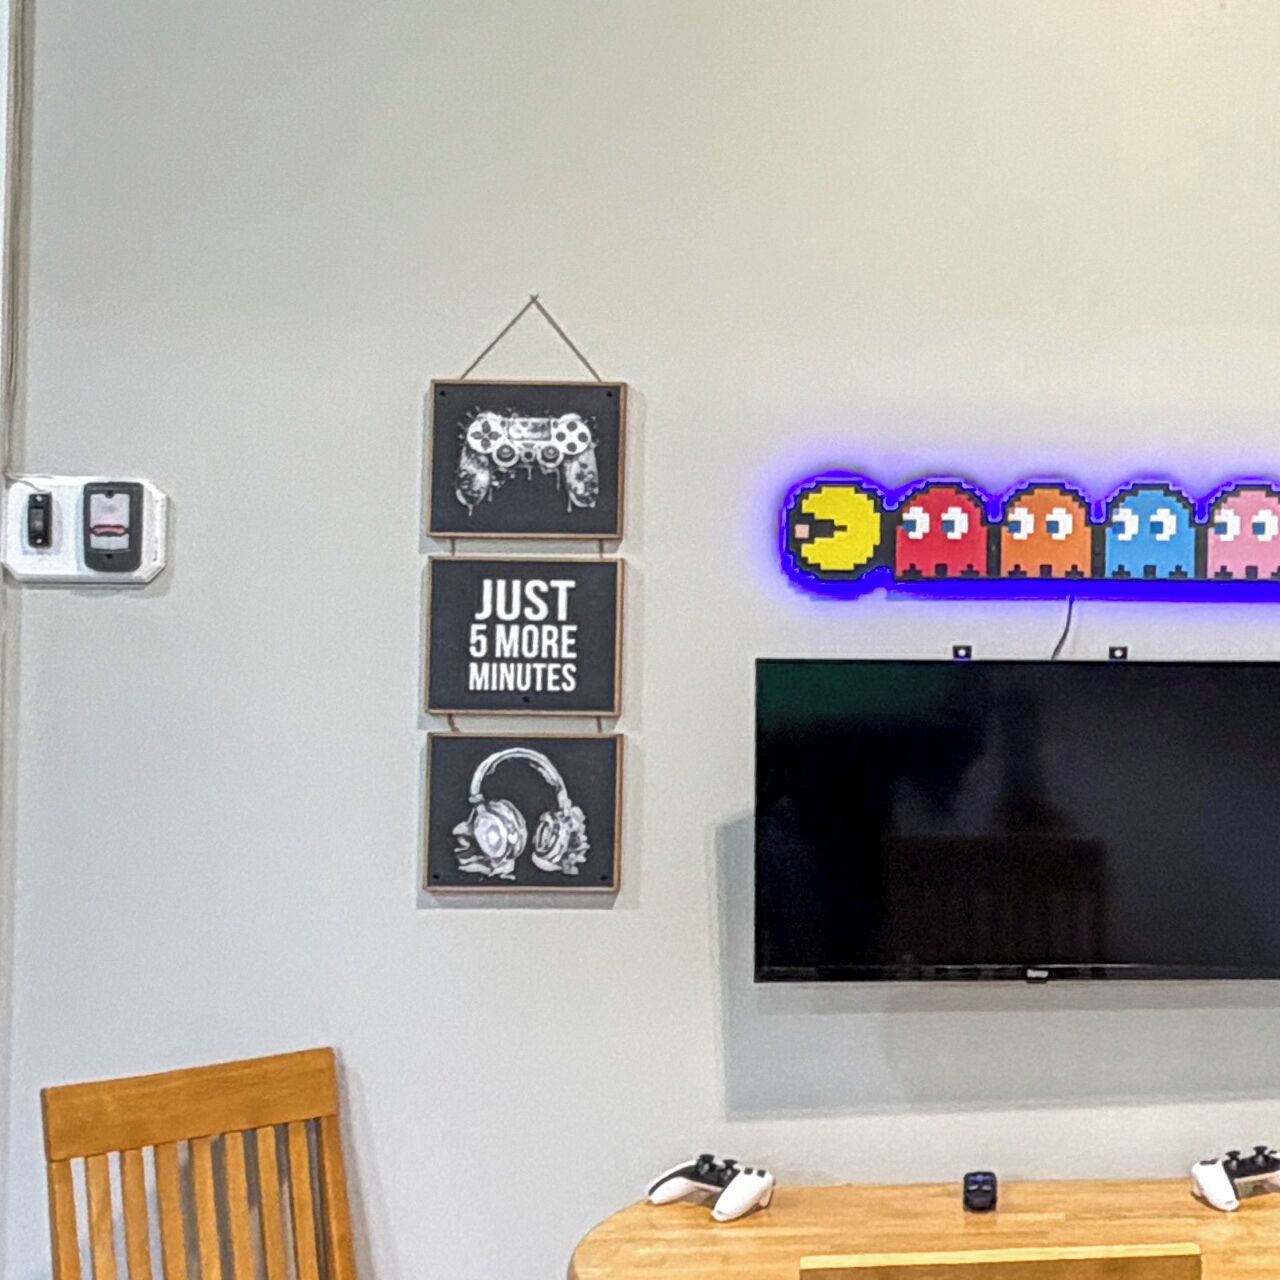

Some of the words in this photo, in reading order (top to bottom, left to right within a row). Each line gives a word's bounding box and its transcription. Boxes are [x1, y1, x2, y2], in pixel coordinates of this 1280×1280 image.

[474, 578, 577, 622] JUST
[469, 623, 488, 658] 5
[494, 623, 578, 659] MORE
[468, 662, 578, 692] MINUTES
